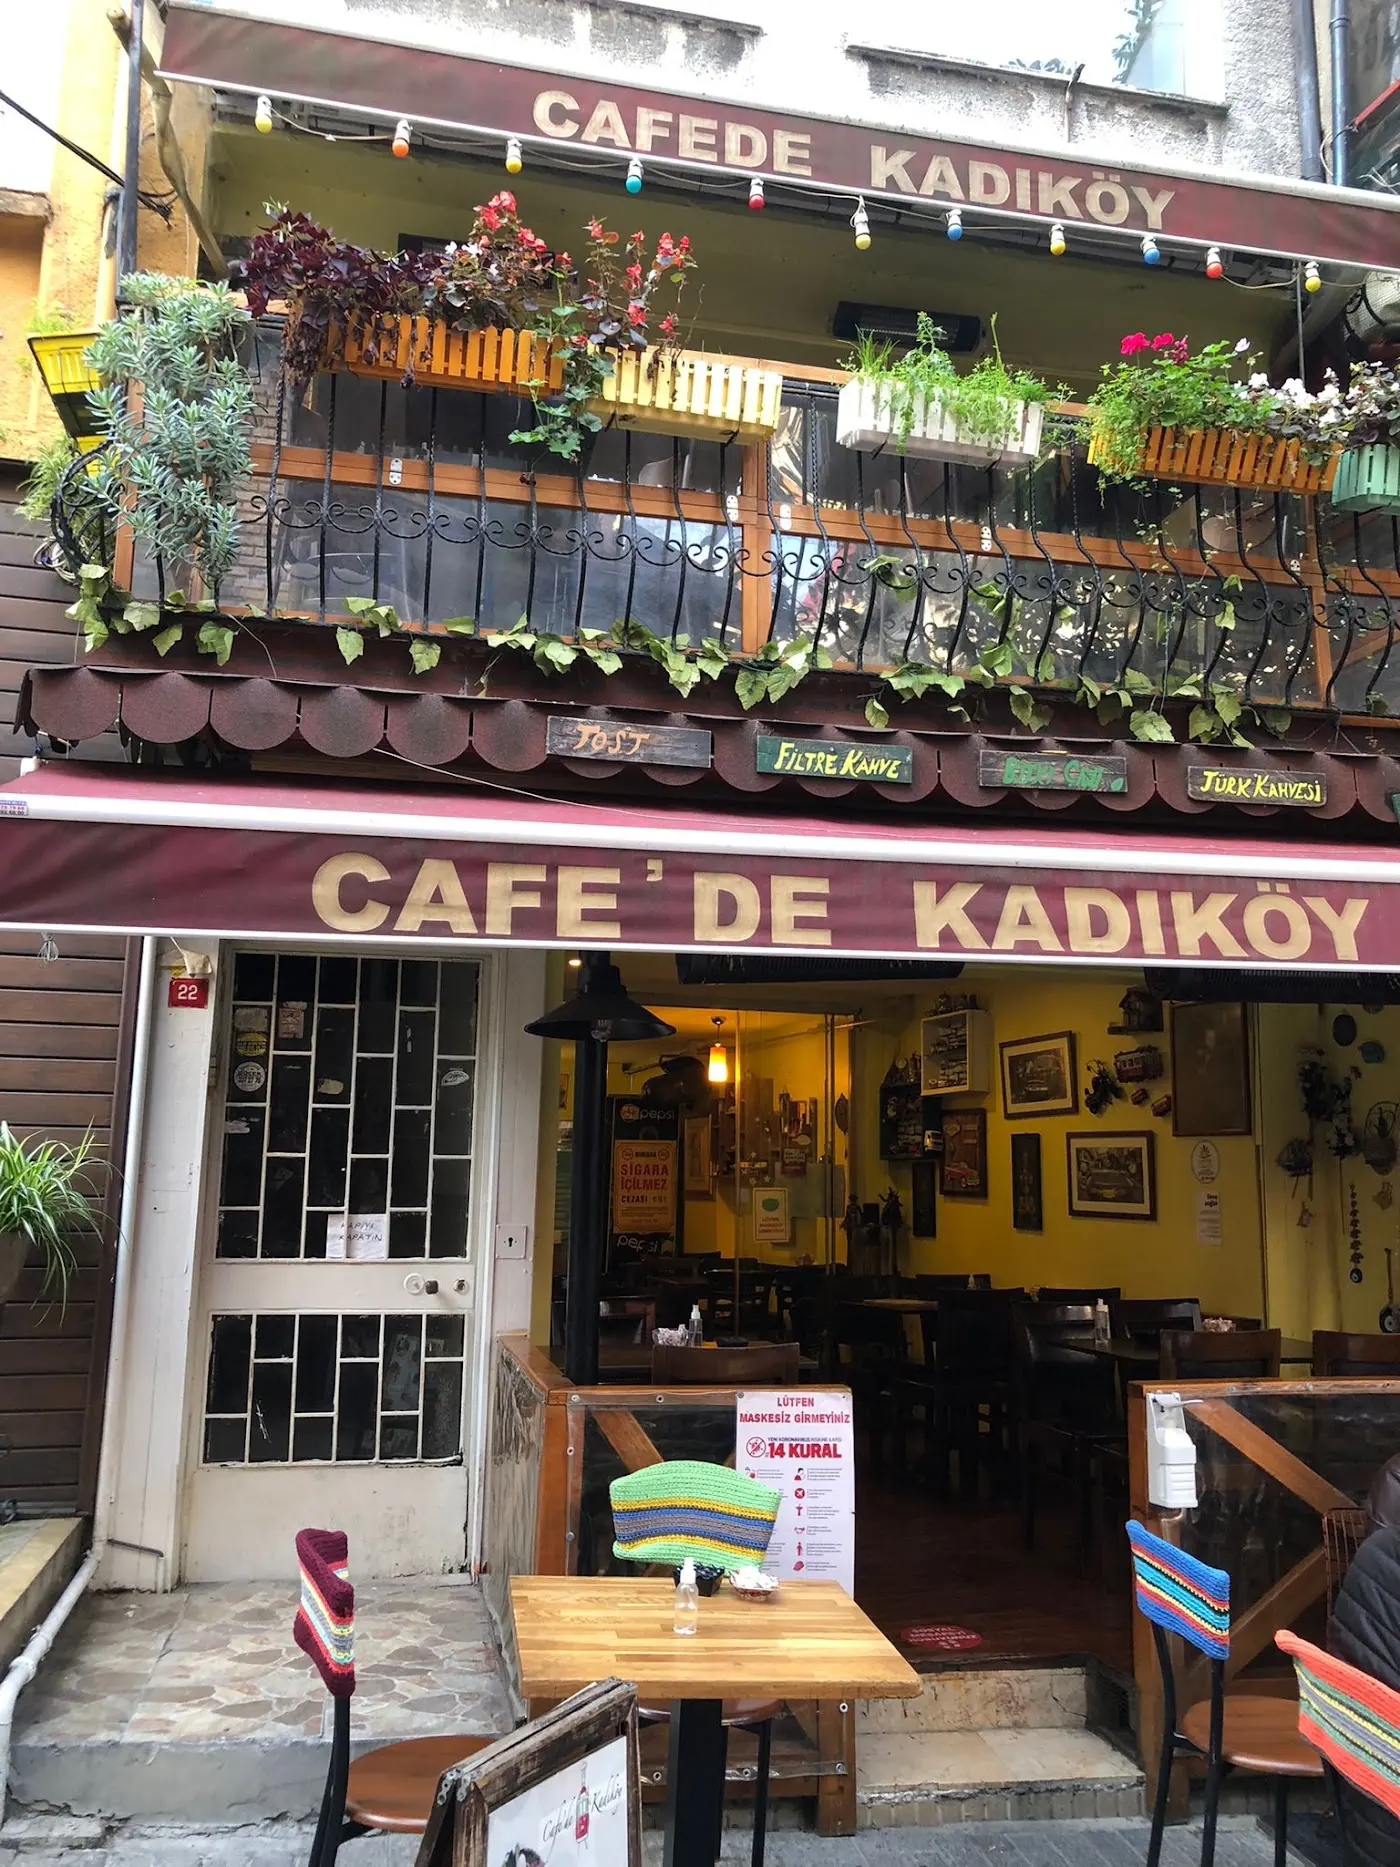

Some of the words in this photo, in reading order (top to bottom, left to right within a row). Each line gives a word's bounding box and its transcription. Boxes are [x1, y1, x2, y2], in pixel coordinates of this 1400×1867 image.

[532, 89, 812, 177] CAFEDE
[869, 144, 1175, 231] KADIKÖY
[572, 723, 651, 756] TOST
[839, 748, 902, 779] KAHVE
[1200, 770, 1252, 799] TÜRK
[1252, 774, 1322, 803] KAHVESİ
[913, 879, 1370, 962] KADIKÖY
[177, 983, 198, 1000] 22
[640, 1107, 674, 1121] pepsi
[620, 1162, 669, 1176] SİGARA
[620, 1176, 668, 1192] İÇİLMEZ
[777, 1395, 815, 1407] LÜTFEN
[739, 1411, 791, 1423] MASKESİZ
[794, 1411, 851, 1424] GİRMEYİNİZ
[768, 1443, 786, 1459] 14
[788, 1443, 843, 1459] KURAL
